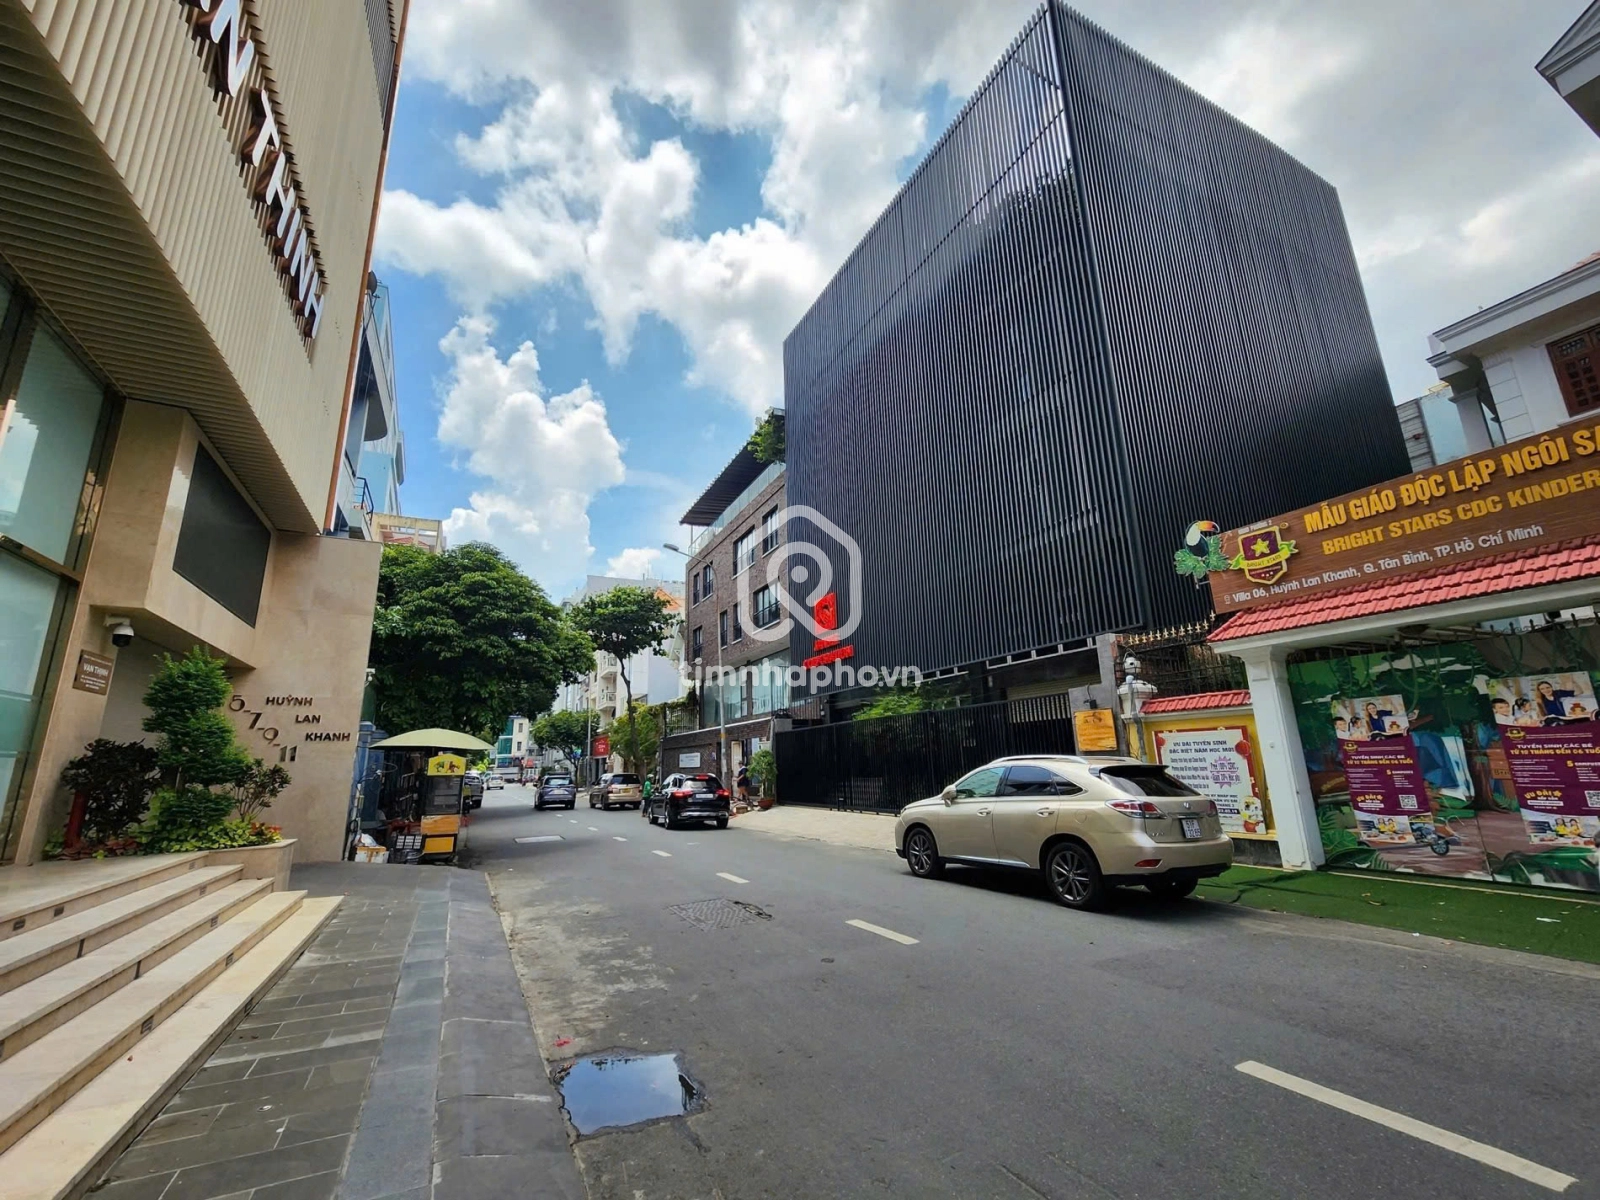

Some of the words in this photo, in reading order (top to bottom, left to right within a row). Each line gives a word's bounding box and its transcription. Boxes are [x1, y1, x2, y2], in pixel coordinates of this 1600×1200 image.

[1303, 502, 1347, 534] MẪU
[1348, 488, 1397, 520] GIÁO
[1399, 474, 1446, 505] ĐỘC
[1448, 458, 1496, 491] LẬP
[1501, 435, 1570, 477] NGÔI
[1322, 526, 1384, 555] BRIGHT
[1388, 509, 1453, 538] STARS
[1457, 496, 1503, 520] CDC
[1232, 591, 1251, 603] Villa
[1270, 580, 1300, 595] Huỳnh
[1302, 576, 1320, 588] Lan
[1322, 567, 1361, 584] Khanh,
[1363, 563, 1378, 574] Q.
[1378, 557, 1401, 570] Tân
[1404, 550, 1434, 566] Bình,
[1478, 529, 1504, 548] Chí
[1507, 524, 1544, 542] Minh
[265, 694, 313, 706] HUỲNH
[295, 714, 321, 723] LAN
[305, 732, 351, 742] KHANH
